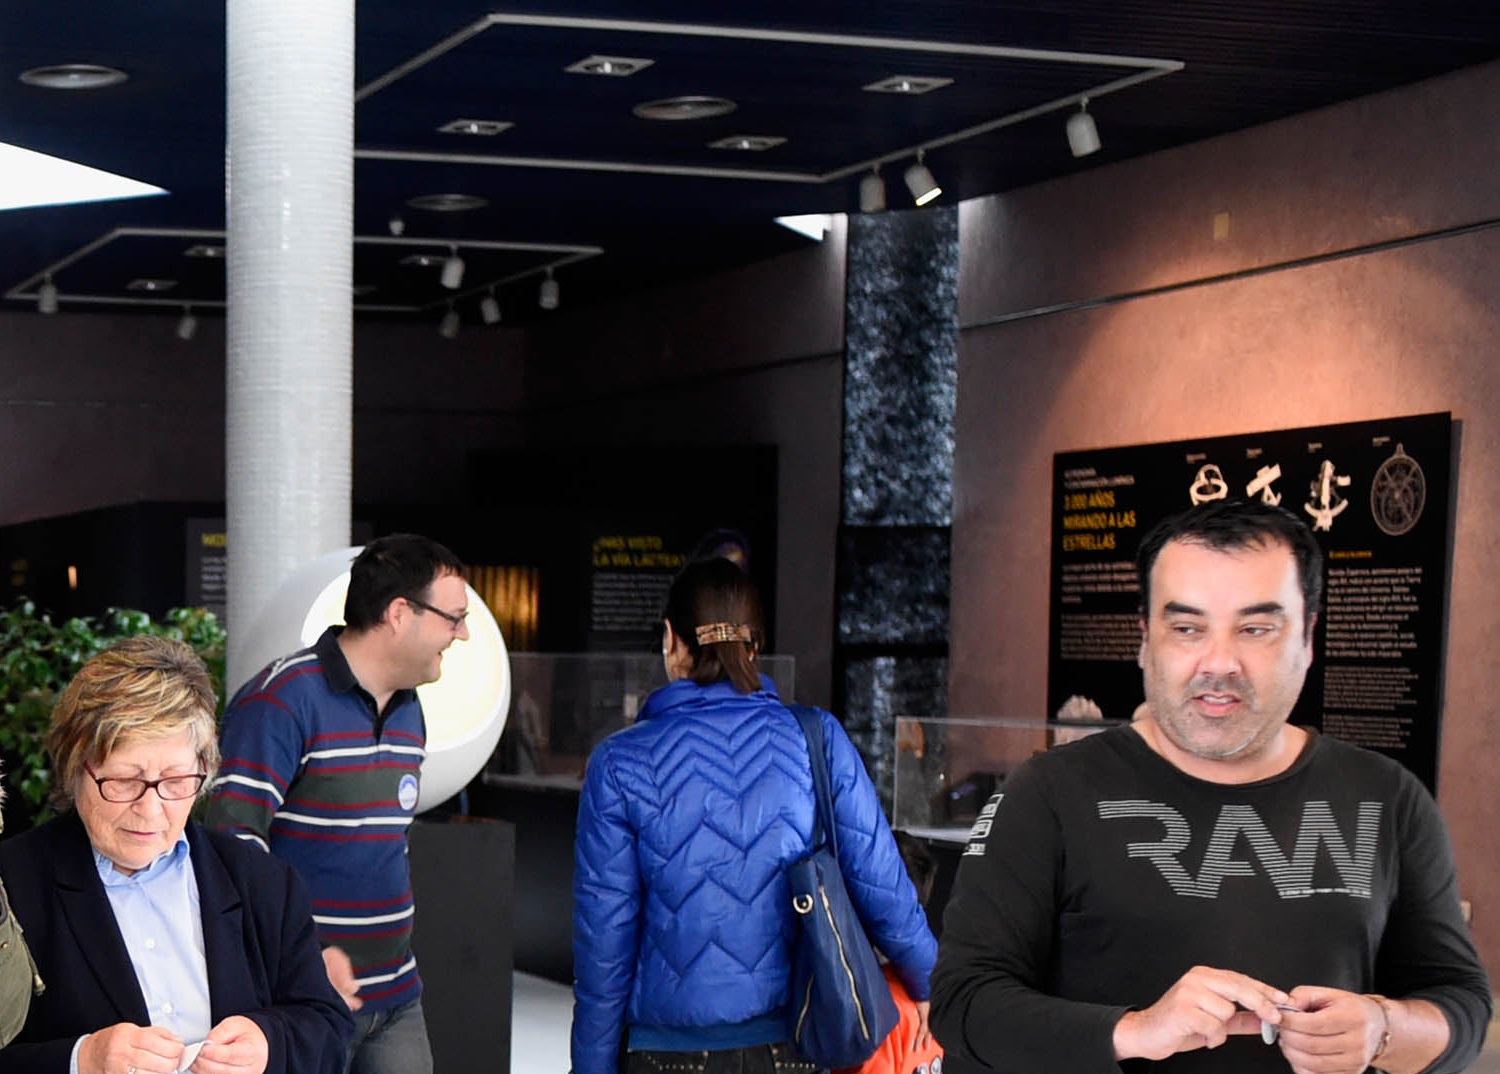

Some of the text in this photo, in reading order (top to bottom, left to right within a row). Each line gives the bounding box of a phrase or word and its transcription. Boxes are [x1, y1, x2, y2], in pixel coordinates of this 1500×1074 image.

[1089, 490, 1115, 508] AÑOS
[1063, 510, 1136, 530] MIRANDO A LAS
[1063, 533, 1116, 551] ESTRELLAS
[1098, 800, 1382, 899] RAW
